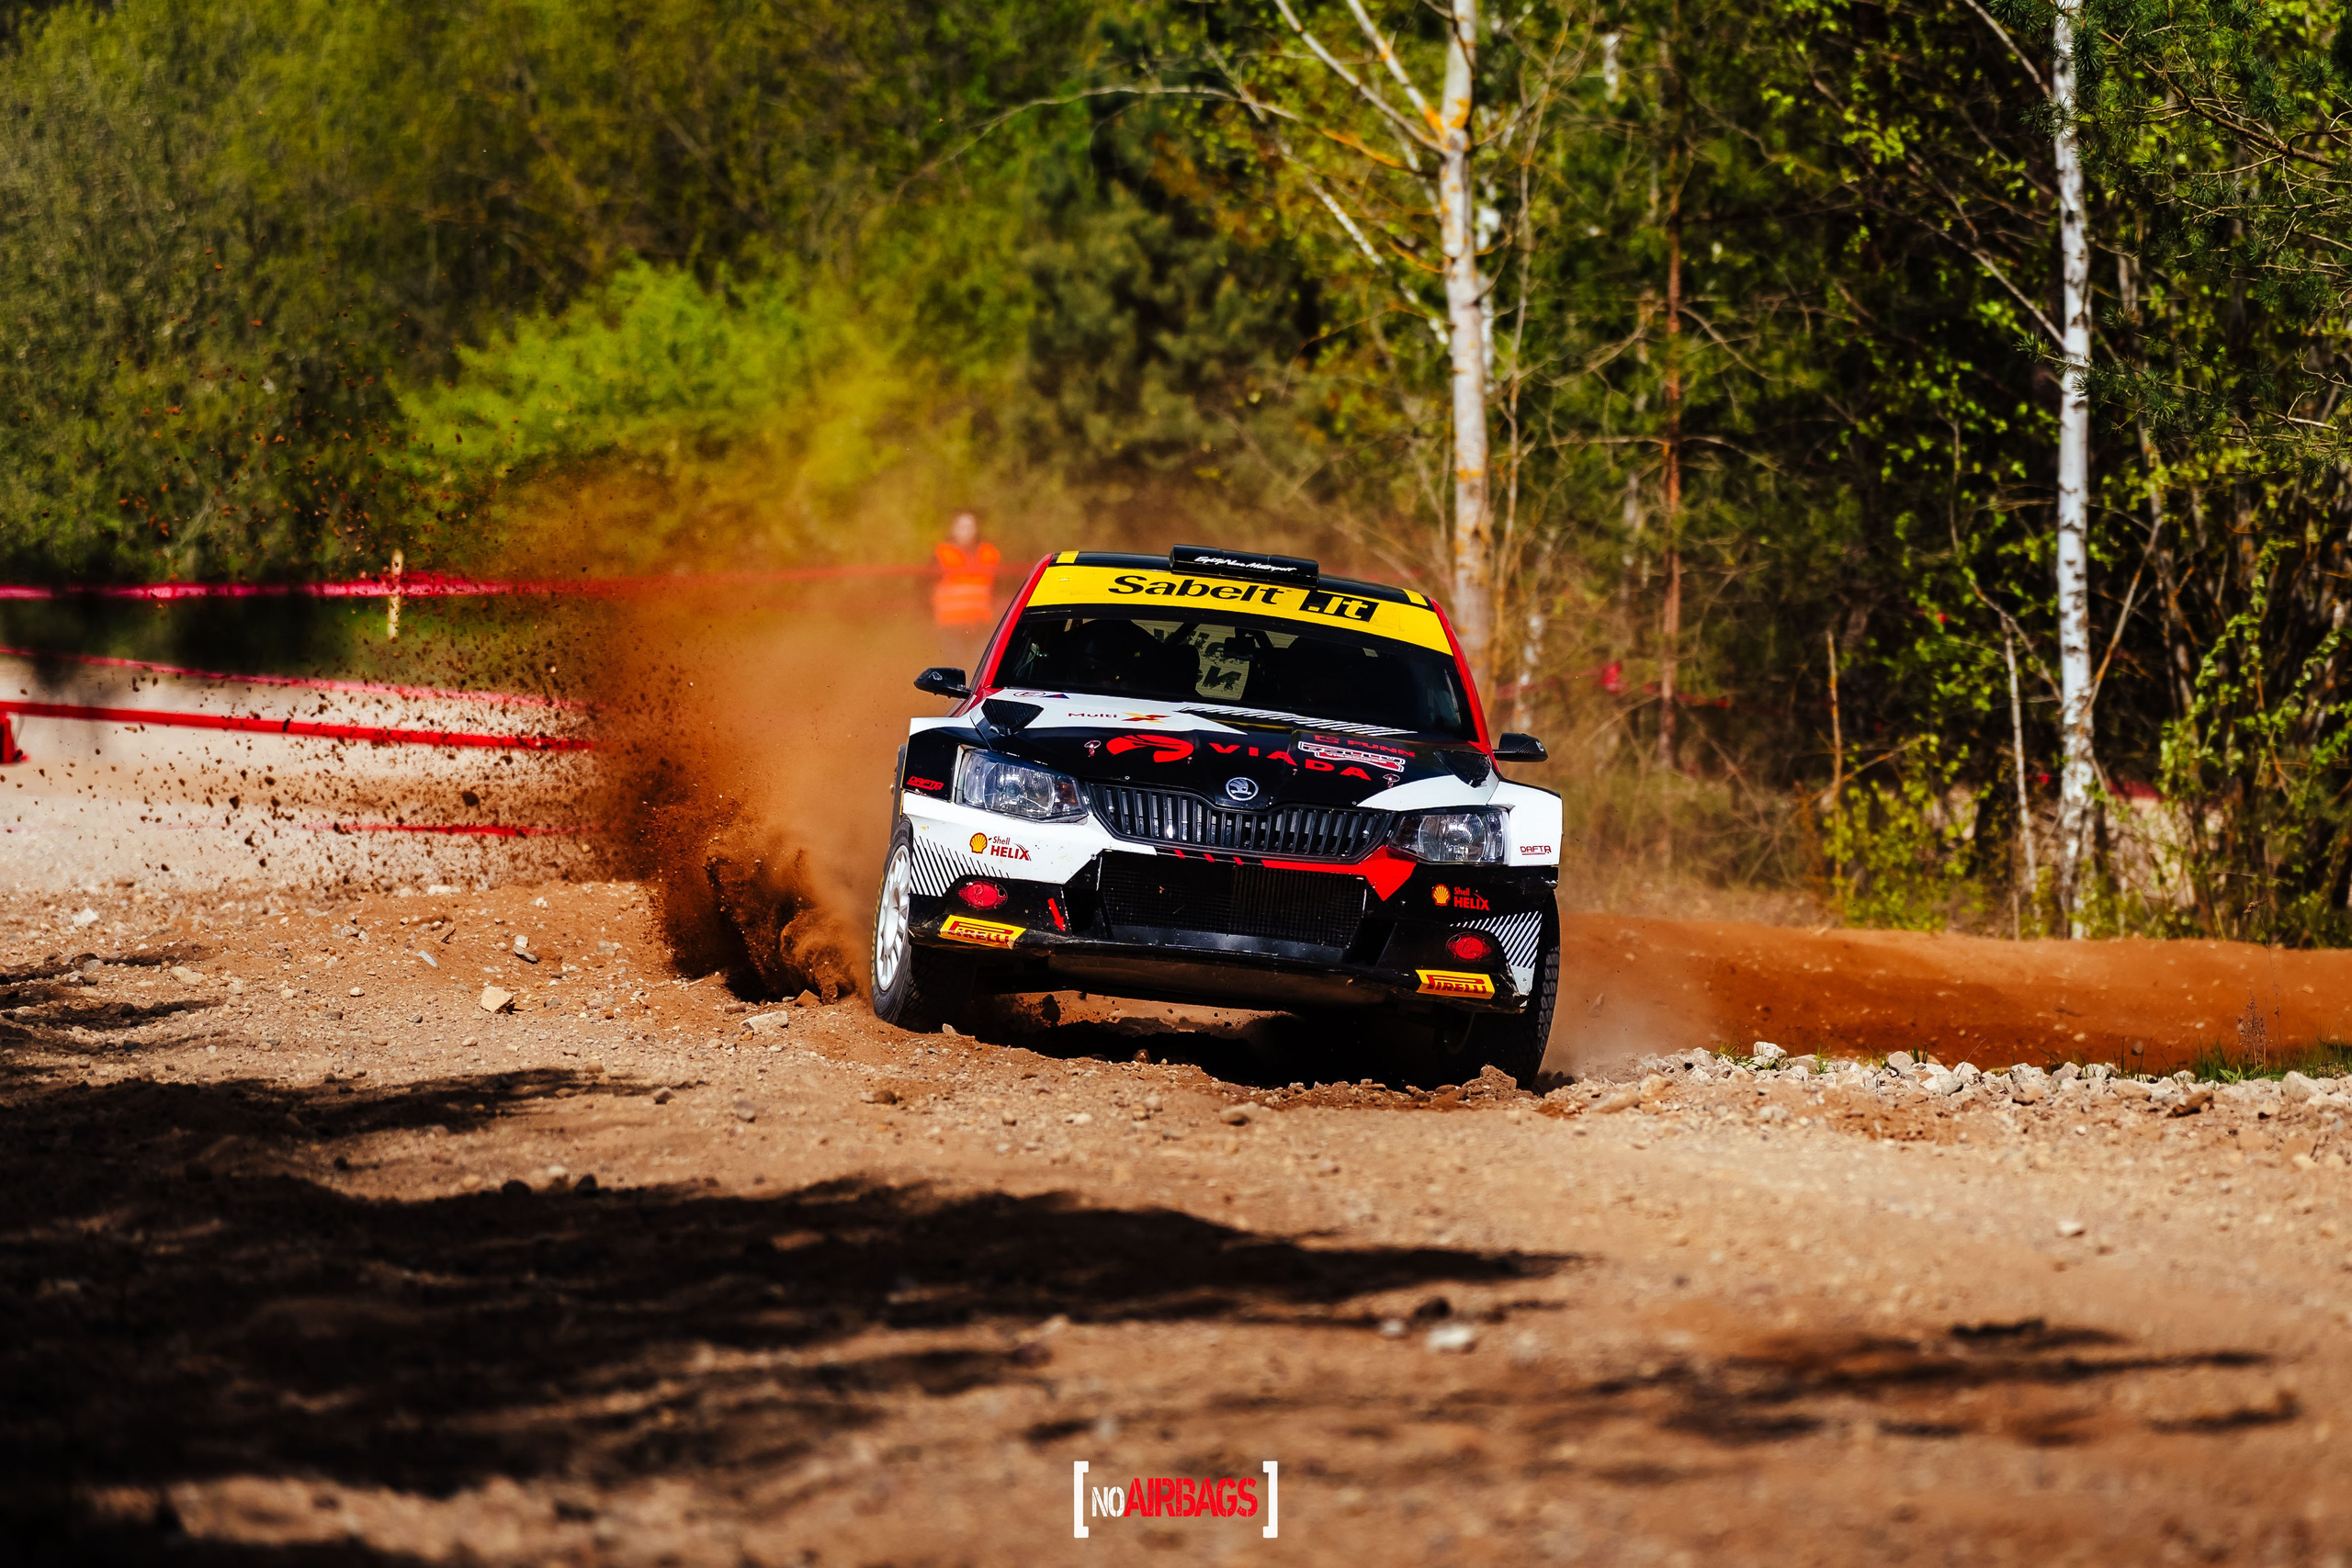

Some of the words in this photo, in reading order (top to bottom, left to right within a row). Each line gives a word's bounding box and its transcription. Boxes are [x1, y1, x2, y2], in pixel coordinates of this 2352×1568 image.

[1108, 575, 1285, 605] Sabelt
[1208, 742, 1372, 781] VIADA
[992, 836, 1011, 846] Shell
[990, 844, 1031, 861] HELIX
[1453, 886, 1470, 896] Shell
[1453, 896, 1490, 911] HELIX
[947, 920, 1014, 944] PIRELLI
[1426, 974, 1487, 994] PIRELLI
